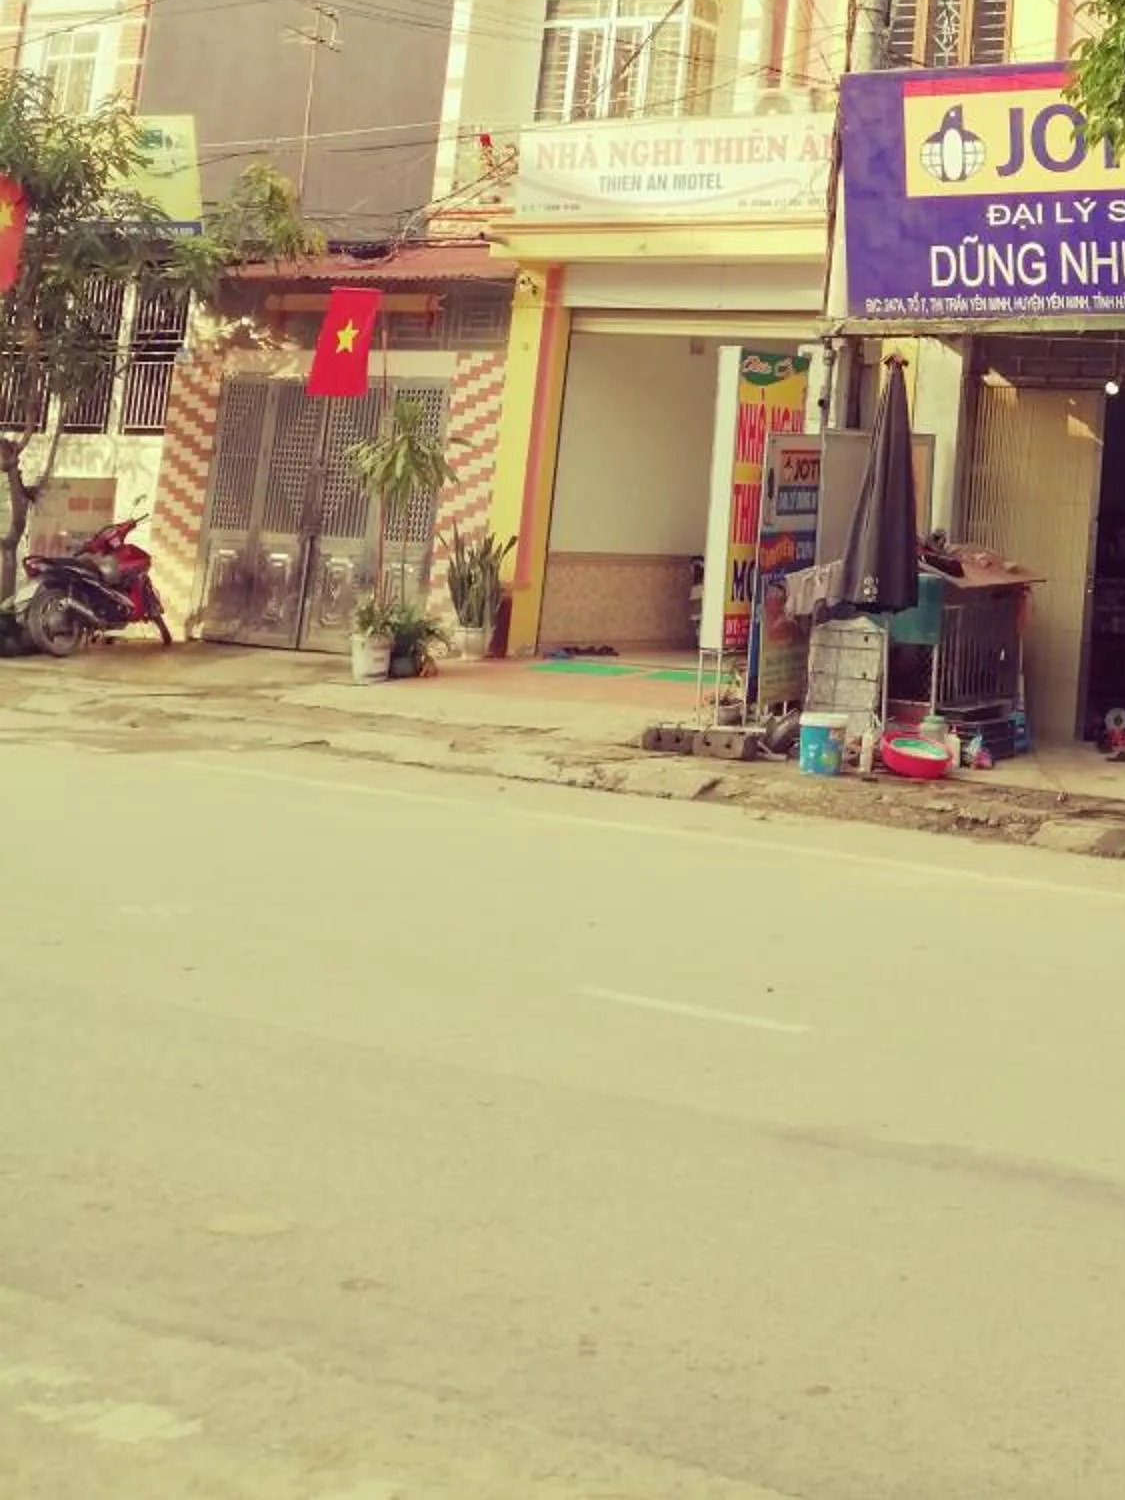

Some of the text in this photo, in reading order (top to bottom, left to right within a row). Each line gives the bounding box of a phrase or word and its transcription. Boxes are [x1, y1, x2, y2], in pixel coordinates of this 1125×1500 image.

[608, 126, 687, 167] NGHỈ
[599, 172, 724, 192] THIEN AN MOTEL
[986, 203, 1044, 231] ĐẠI
[1055, 197, 1097, 226] LÝ
[930, 235, 1048, 288] DŨNG
